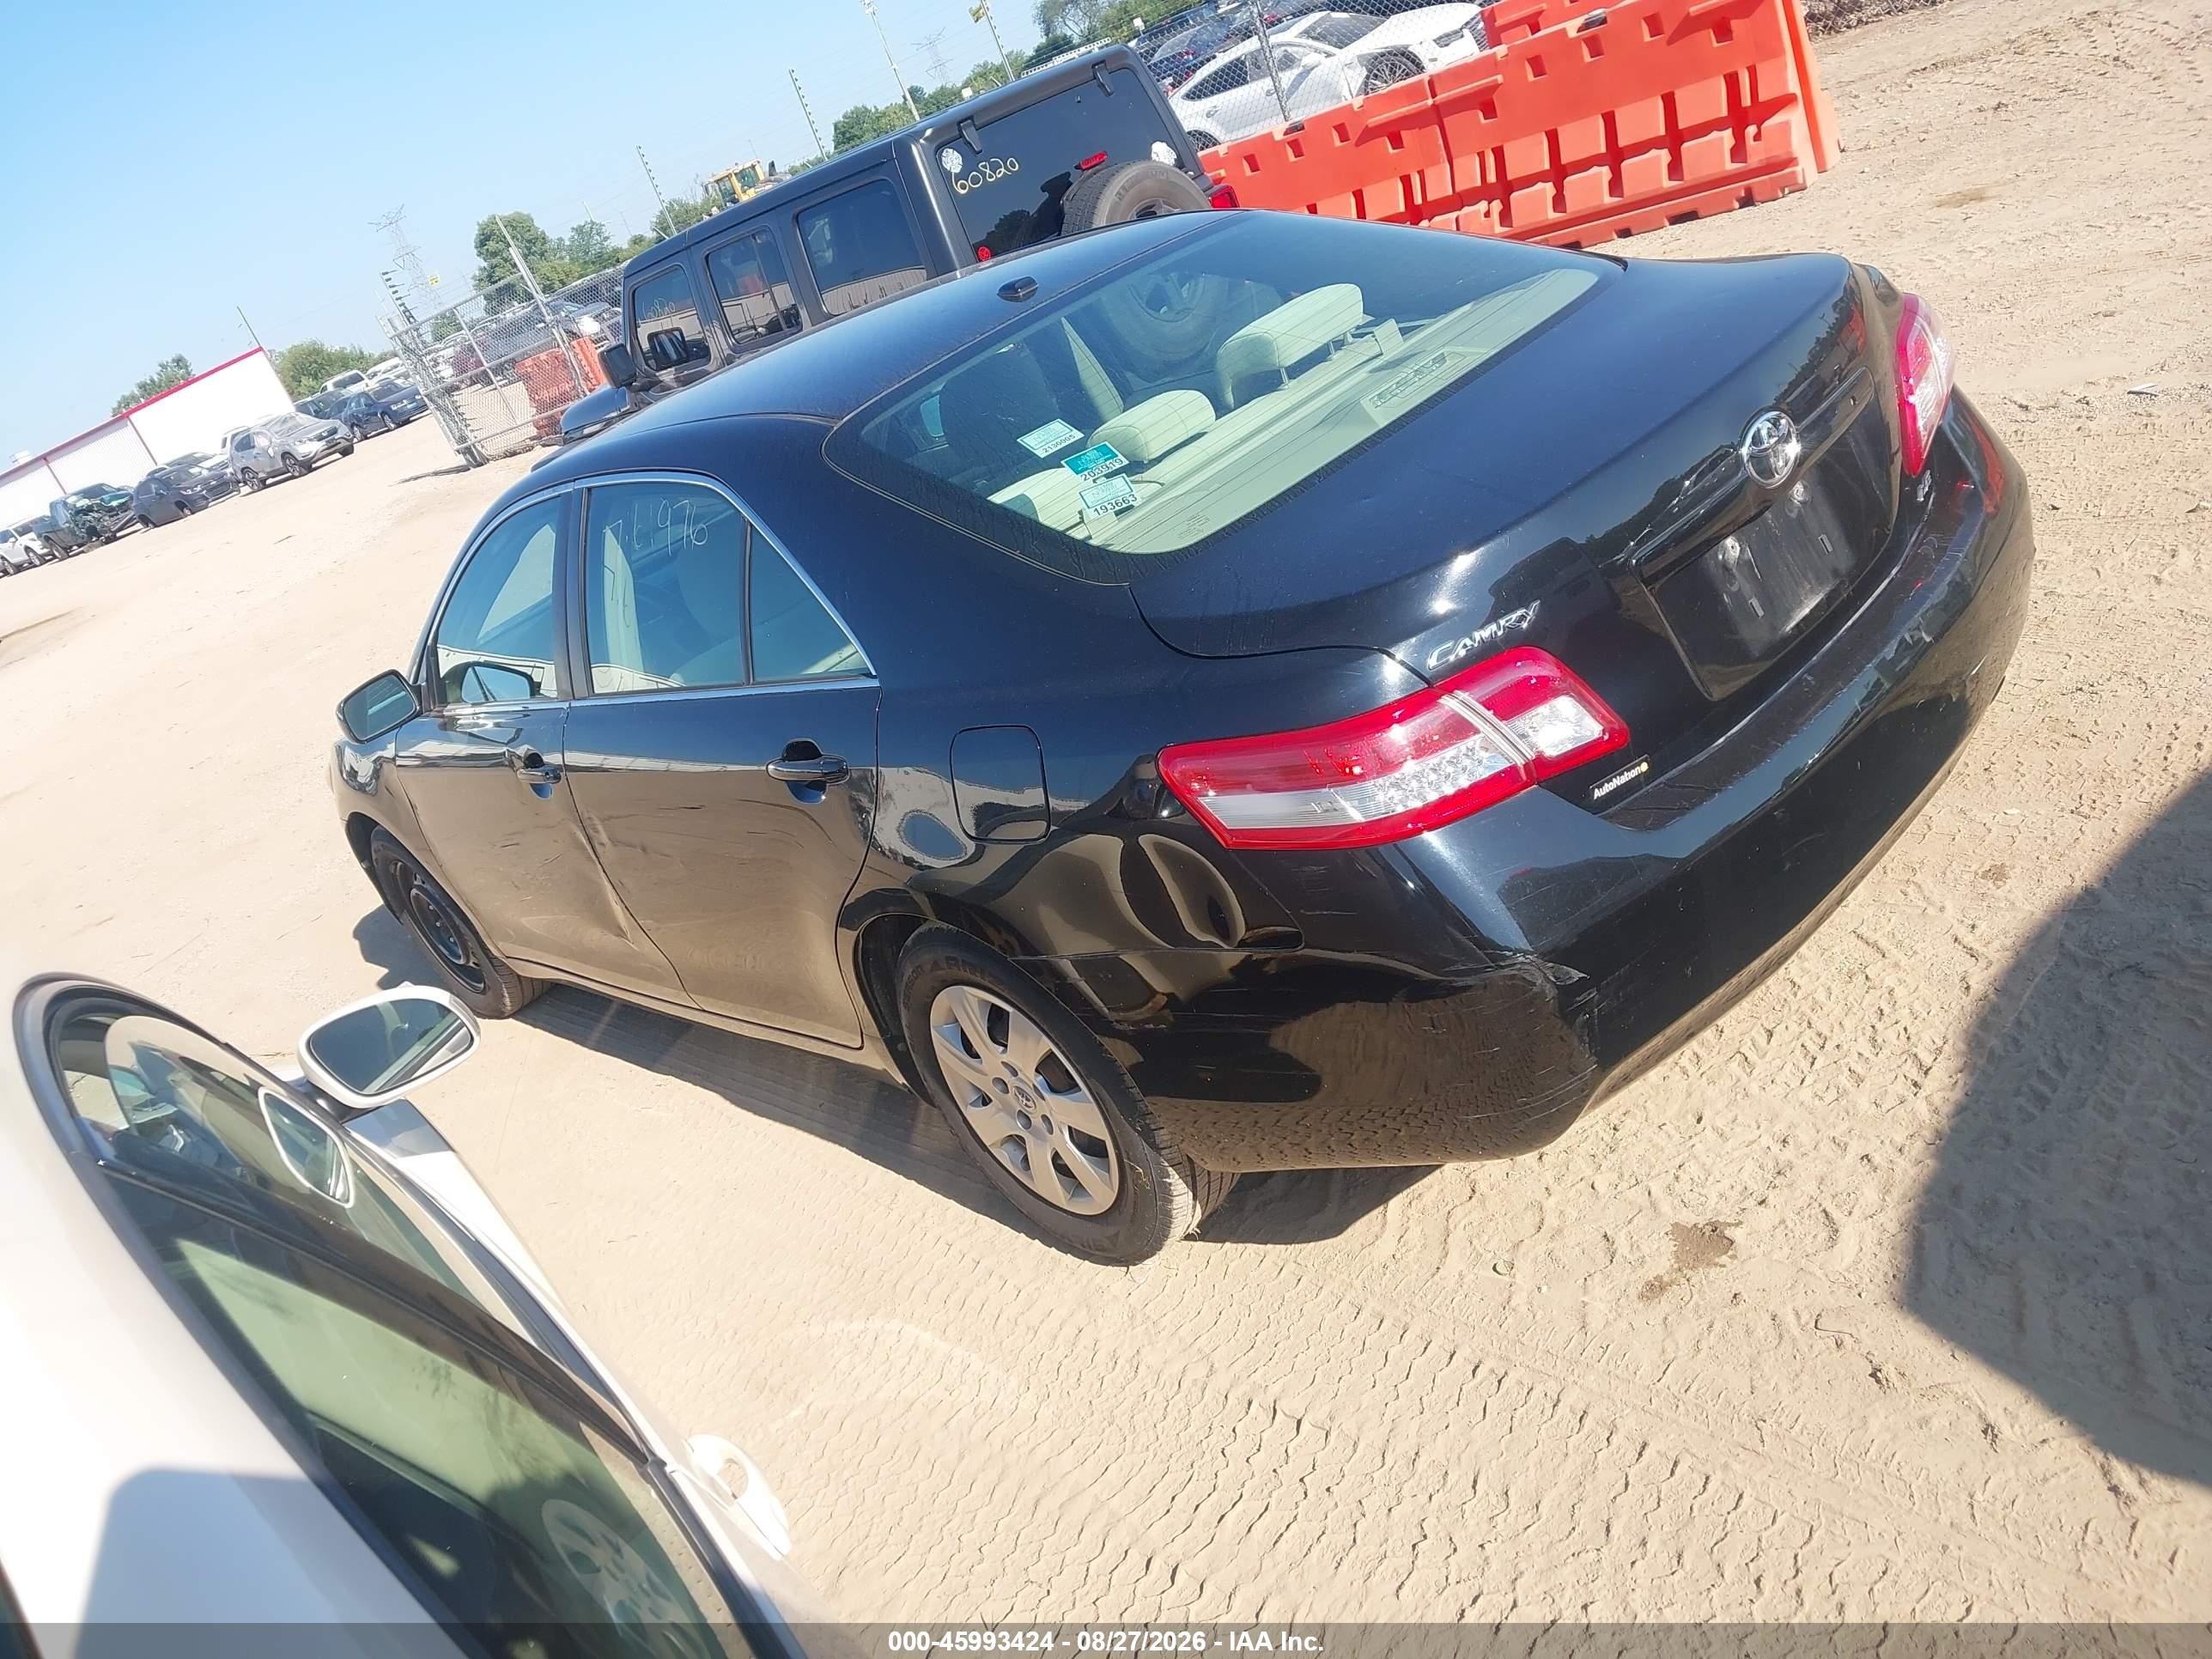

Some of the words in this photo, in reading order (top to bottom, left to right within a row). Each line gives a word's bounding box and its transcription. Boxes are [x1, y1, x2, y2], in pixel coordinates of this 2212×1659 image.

[951, 157, 1019, 194] 60820
[1080, 458, 1124, 482] 203919
[1093, 493, 1138, 517] 193663
[1427, 599, 1540, 671] CAMRY
[1593, 766, 1641, 800] AutoNation
